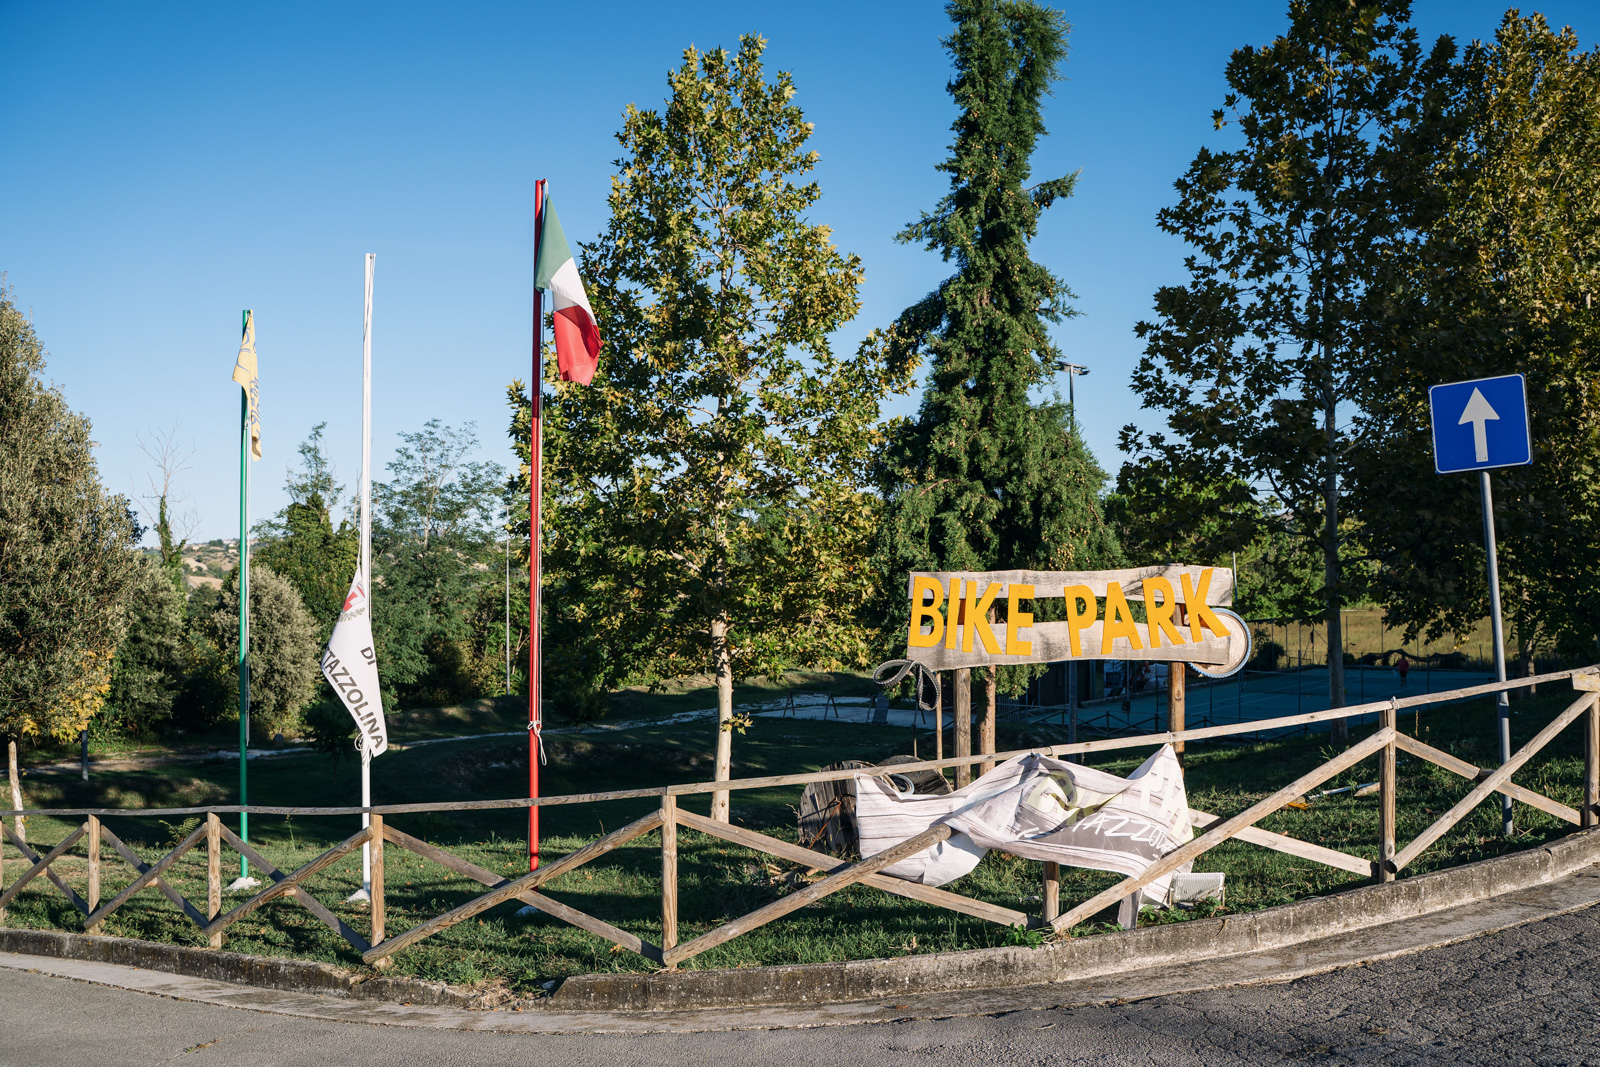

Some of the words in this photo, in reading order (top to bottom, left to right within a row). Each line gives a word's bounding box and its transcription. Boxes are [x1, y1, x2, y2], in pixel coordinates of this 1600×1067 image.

[360, 646, 376, 666] DI
[908, 576, 1035, 656] BIKE
[1064, 568, 1231, 657] PARK
[322, 646, 384, 750] TAZZOLINA
